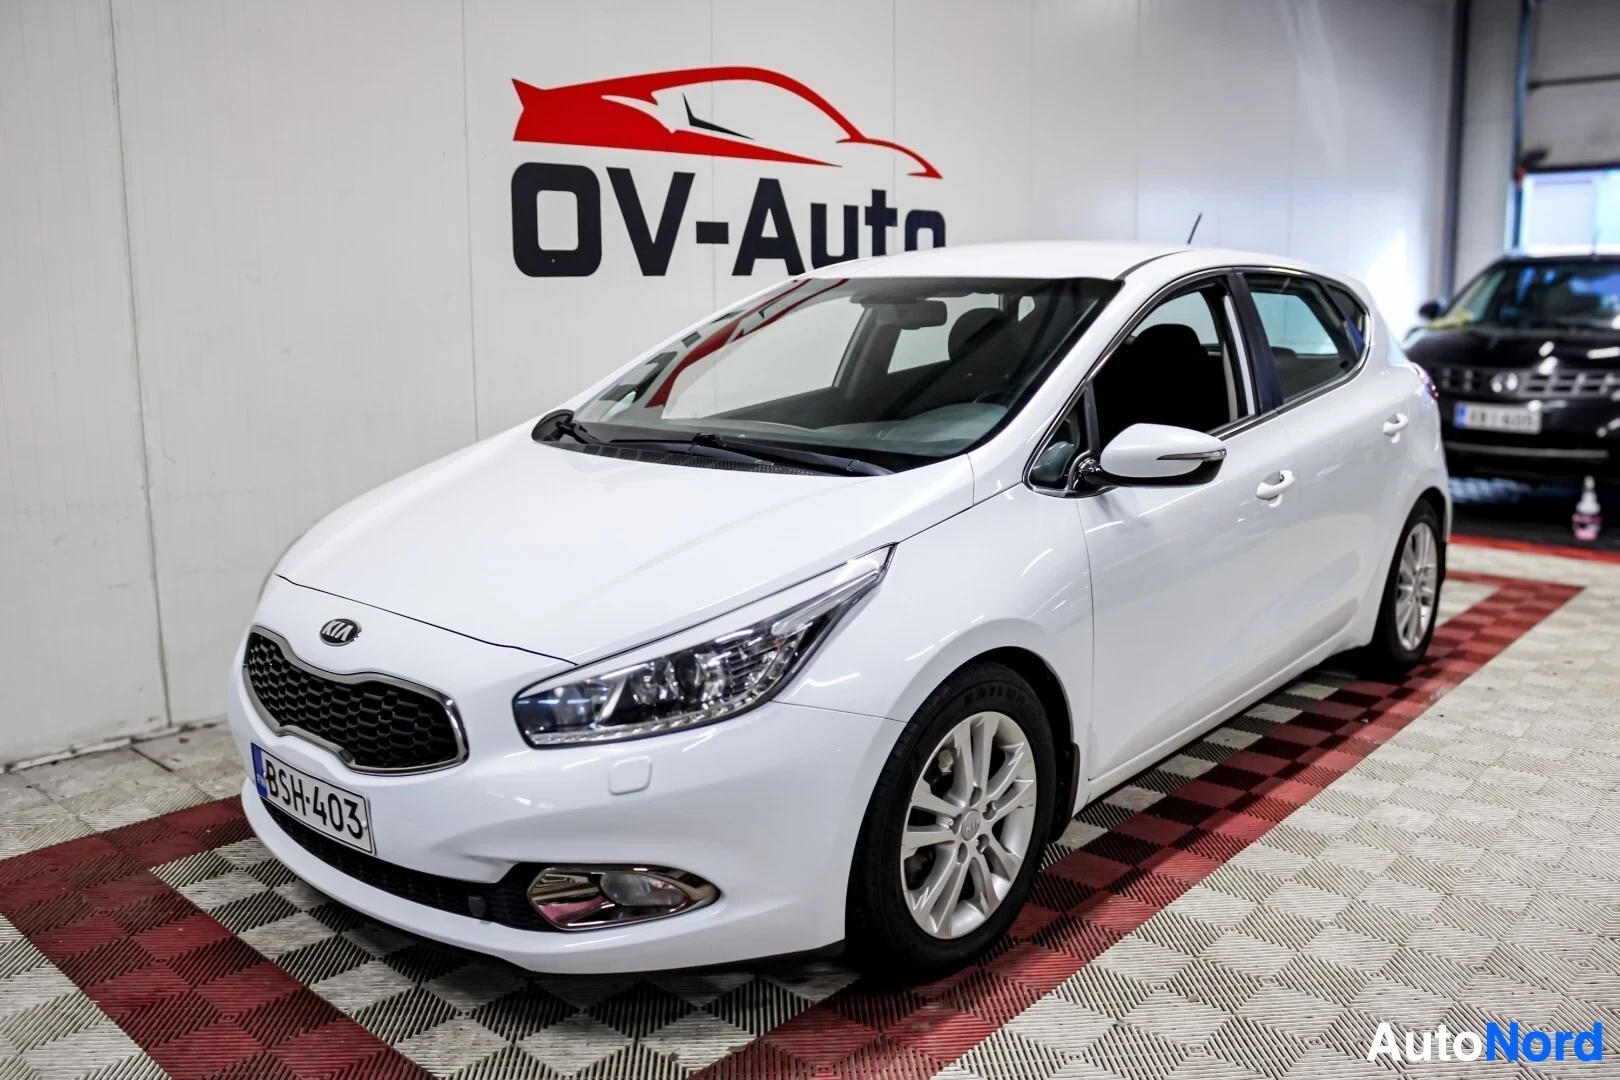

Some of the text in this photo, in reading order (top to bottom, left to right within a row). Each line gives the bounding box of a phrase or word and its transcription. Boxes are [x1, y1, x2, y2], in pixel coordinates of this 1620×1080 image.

[511, 162, 946, 277] OV-Auto
[322, 620, 354, 642] KIA
[265, 759, 364, 840] BSH-403
